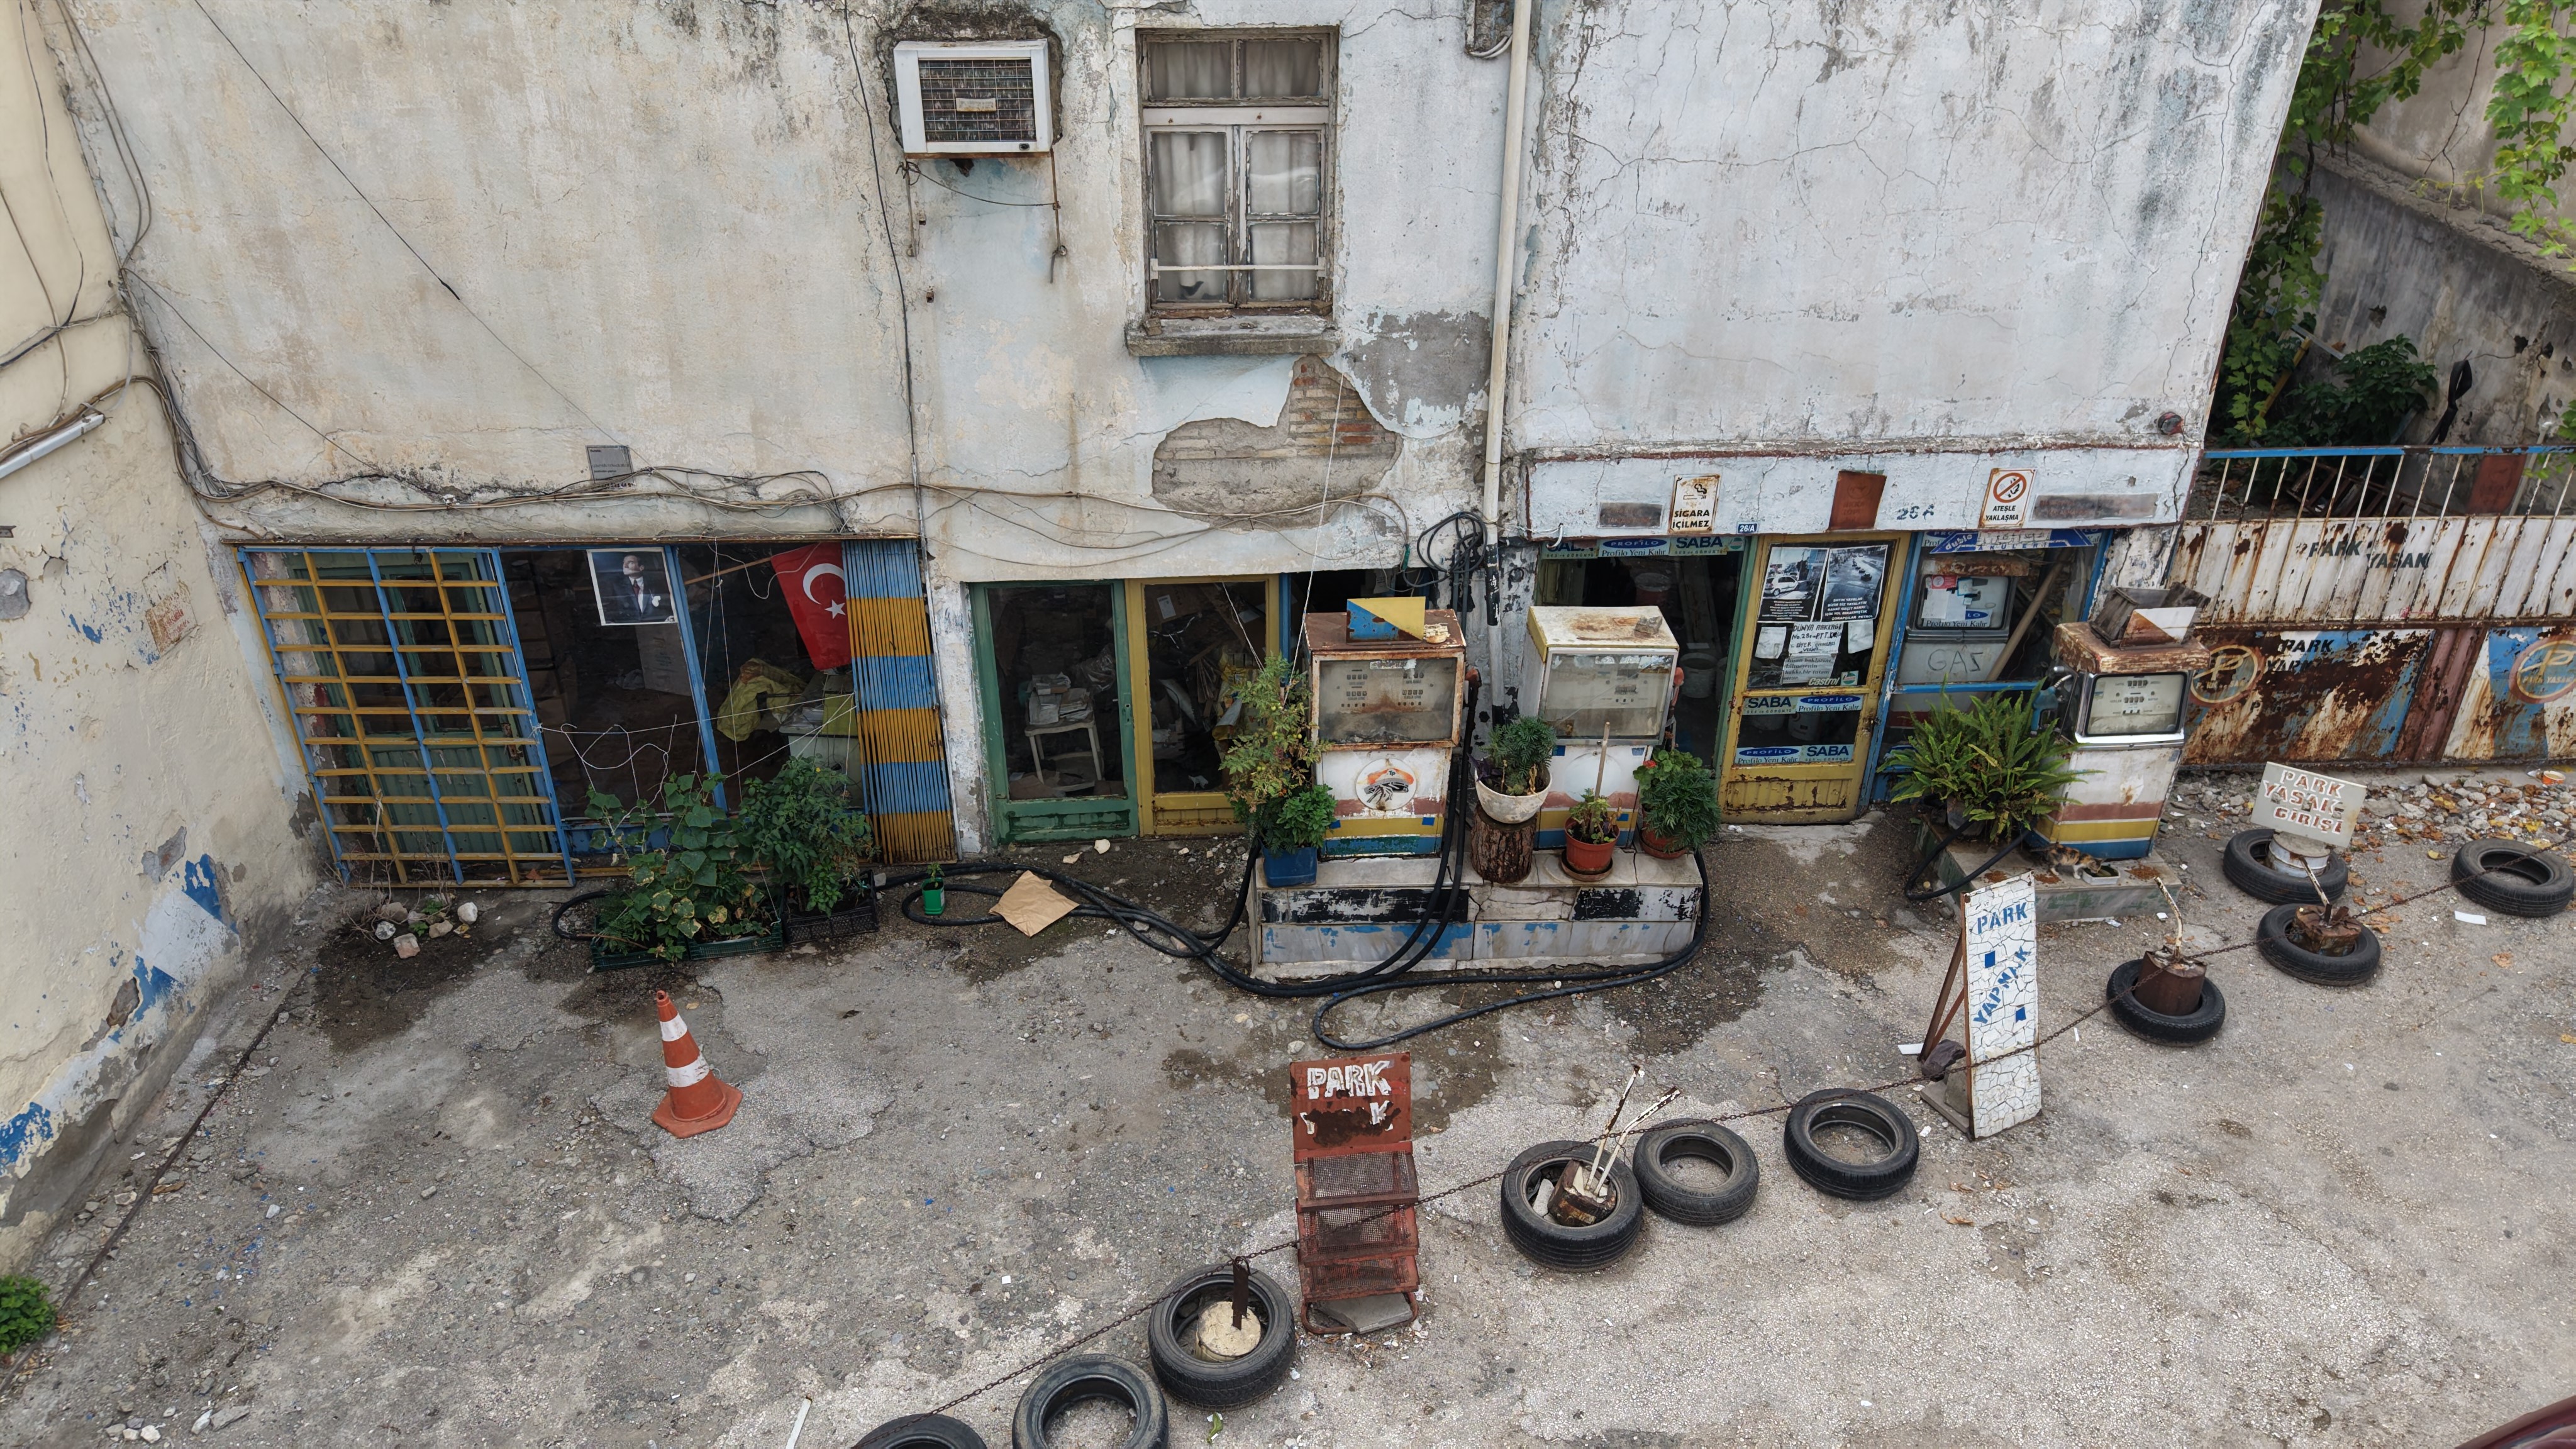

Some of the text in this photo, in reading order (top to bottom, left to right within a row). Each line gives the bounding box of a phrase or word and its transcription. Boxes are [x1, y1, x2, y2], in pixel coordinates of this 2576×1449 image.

[1674, 509, 1710, 518] SİGARA
[1992, 504, 2016, 513] ATEŞLE
[1672, 519, 1709, 529] İÇİLMEZ
[1985, 514, 2019, 522] YAKLAŞMA
[1611, 538, 1659, 547] PROFİLO
[1675, 536, 1723, 548] SABA
[1602, 549, 1628, 557] Profilo
[2308, 541, 2360, 557] PARK
[2366, 552, 2430, 568] YASAK
[1792, 624, 1814, 632] DÜNYA
[2282, 639, 2334, 652] PARK
[1808, 677, 1840, 686] Castrol
[1748, 696, 1792, 709] SABA
[1806, 745, 1849, 757] SABA
[2280, 769, 2345, 799] PARK
[2263, 780, 2342, 816] YASAK
[2273, 806, 2344, 835] GİRİŞİ
[1977, 902, 2028, 935] PARK
[1973, 945, 2032, 1026] YAPMAK
[1307, 1060, 1393, 1100] PARK
